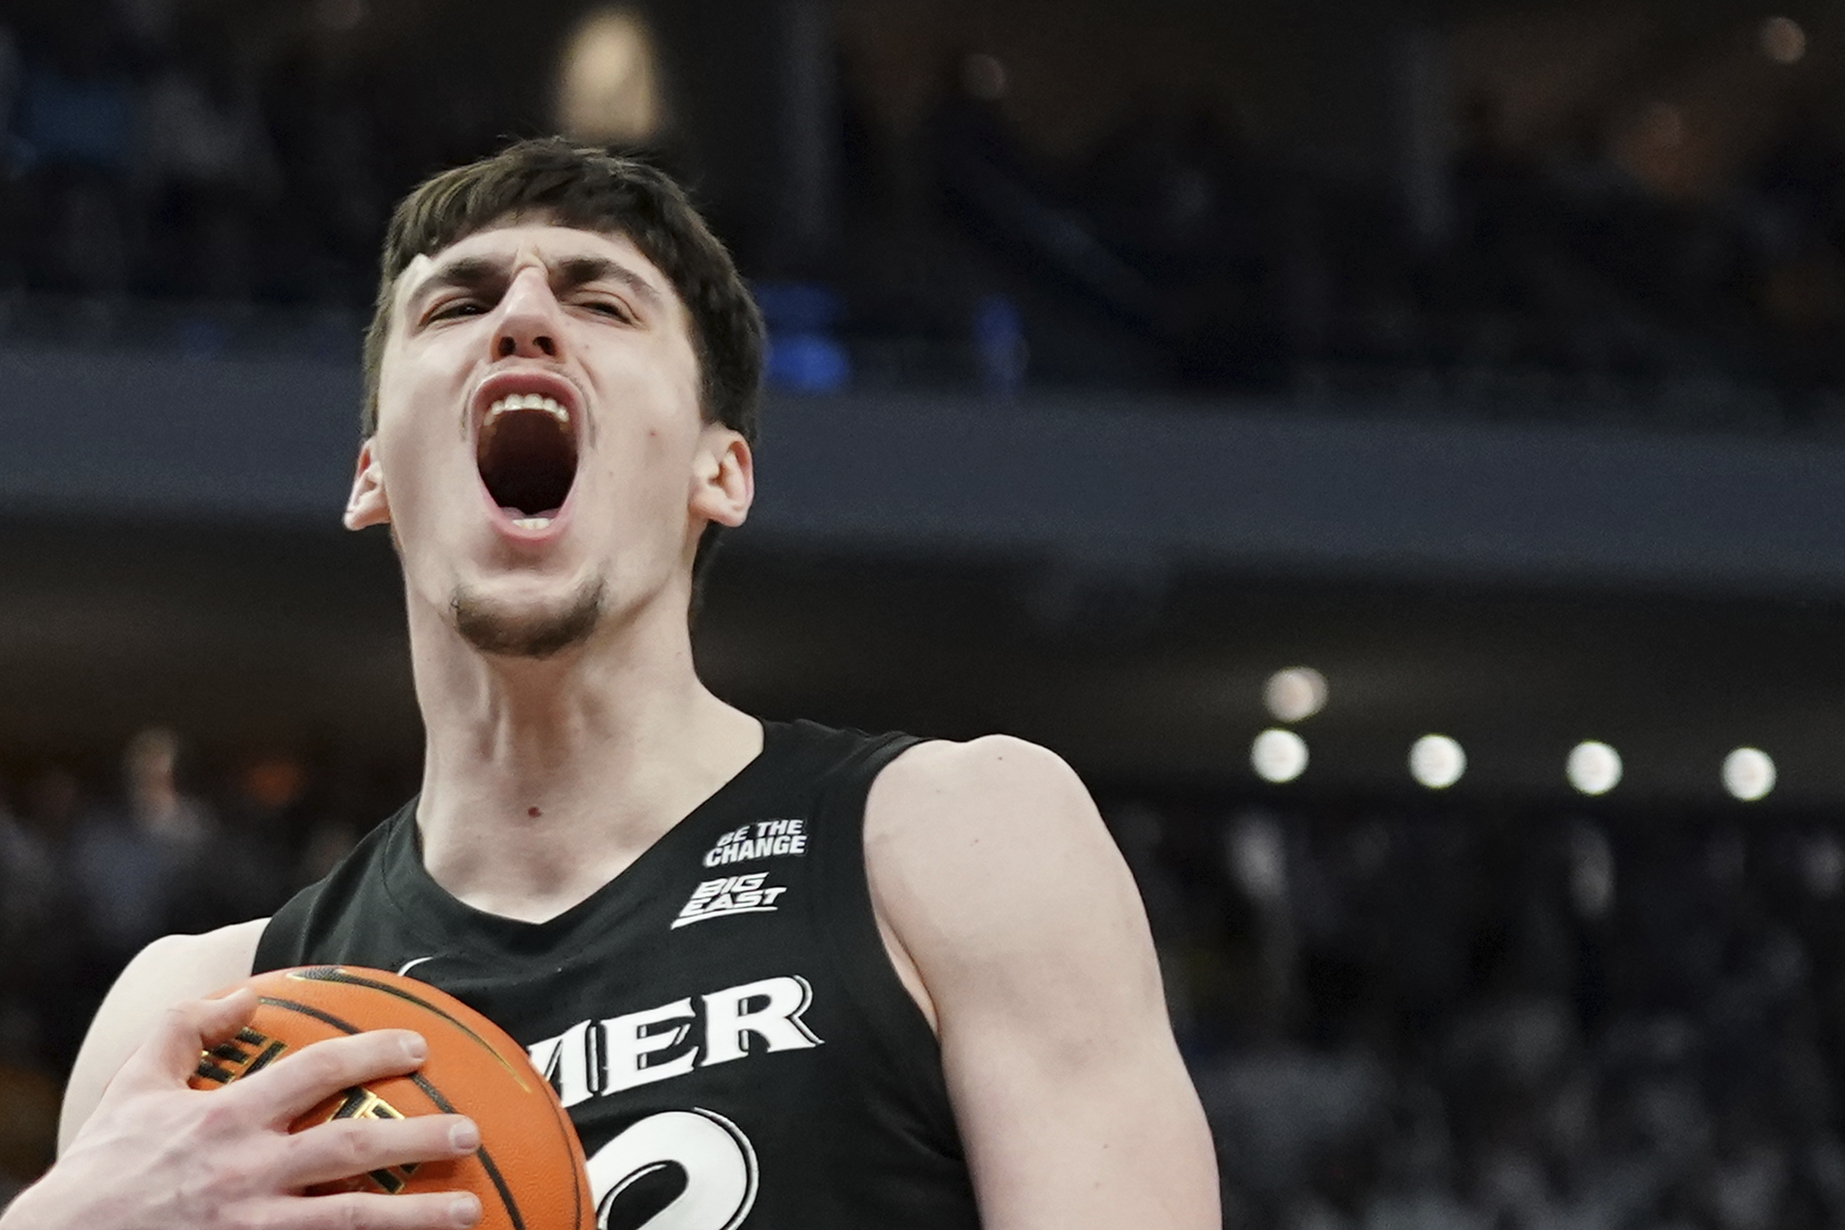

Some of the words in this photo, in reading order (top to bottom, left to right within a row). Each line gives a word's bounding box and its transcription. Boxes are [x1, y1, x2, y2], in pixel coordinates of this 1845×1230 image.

[717, 826, 751, 847] BE
[757, 819, 804, 838] THE
[703, 835, 807, 868] CHANGE
[690, 871, 770, 900] BIG
[678, 886, 788, 918] EAST
[527, 974, 826, 1109] IER
